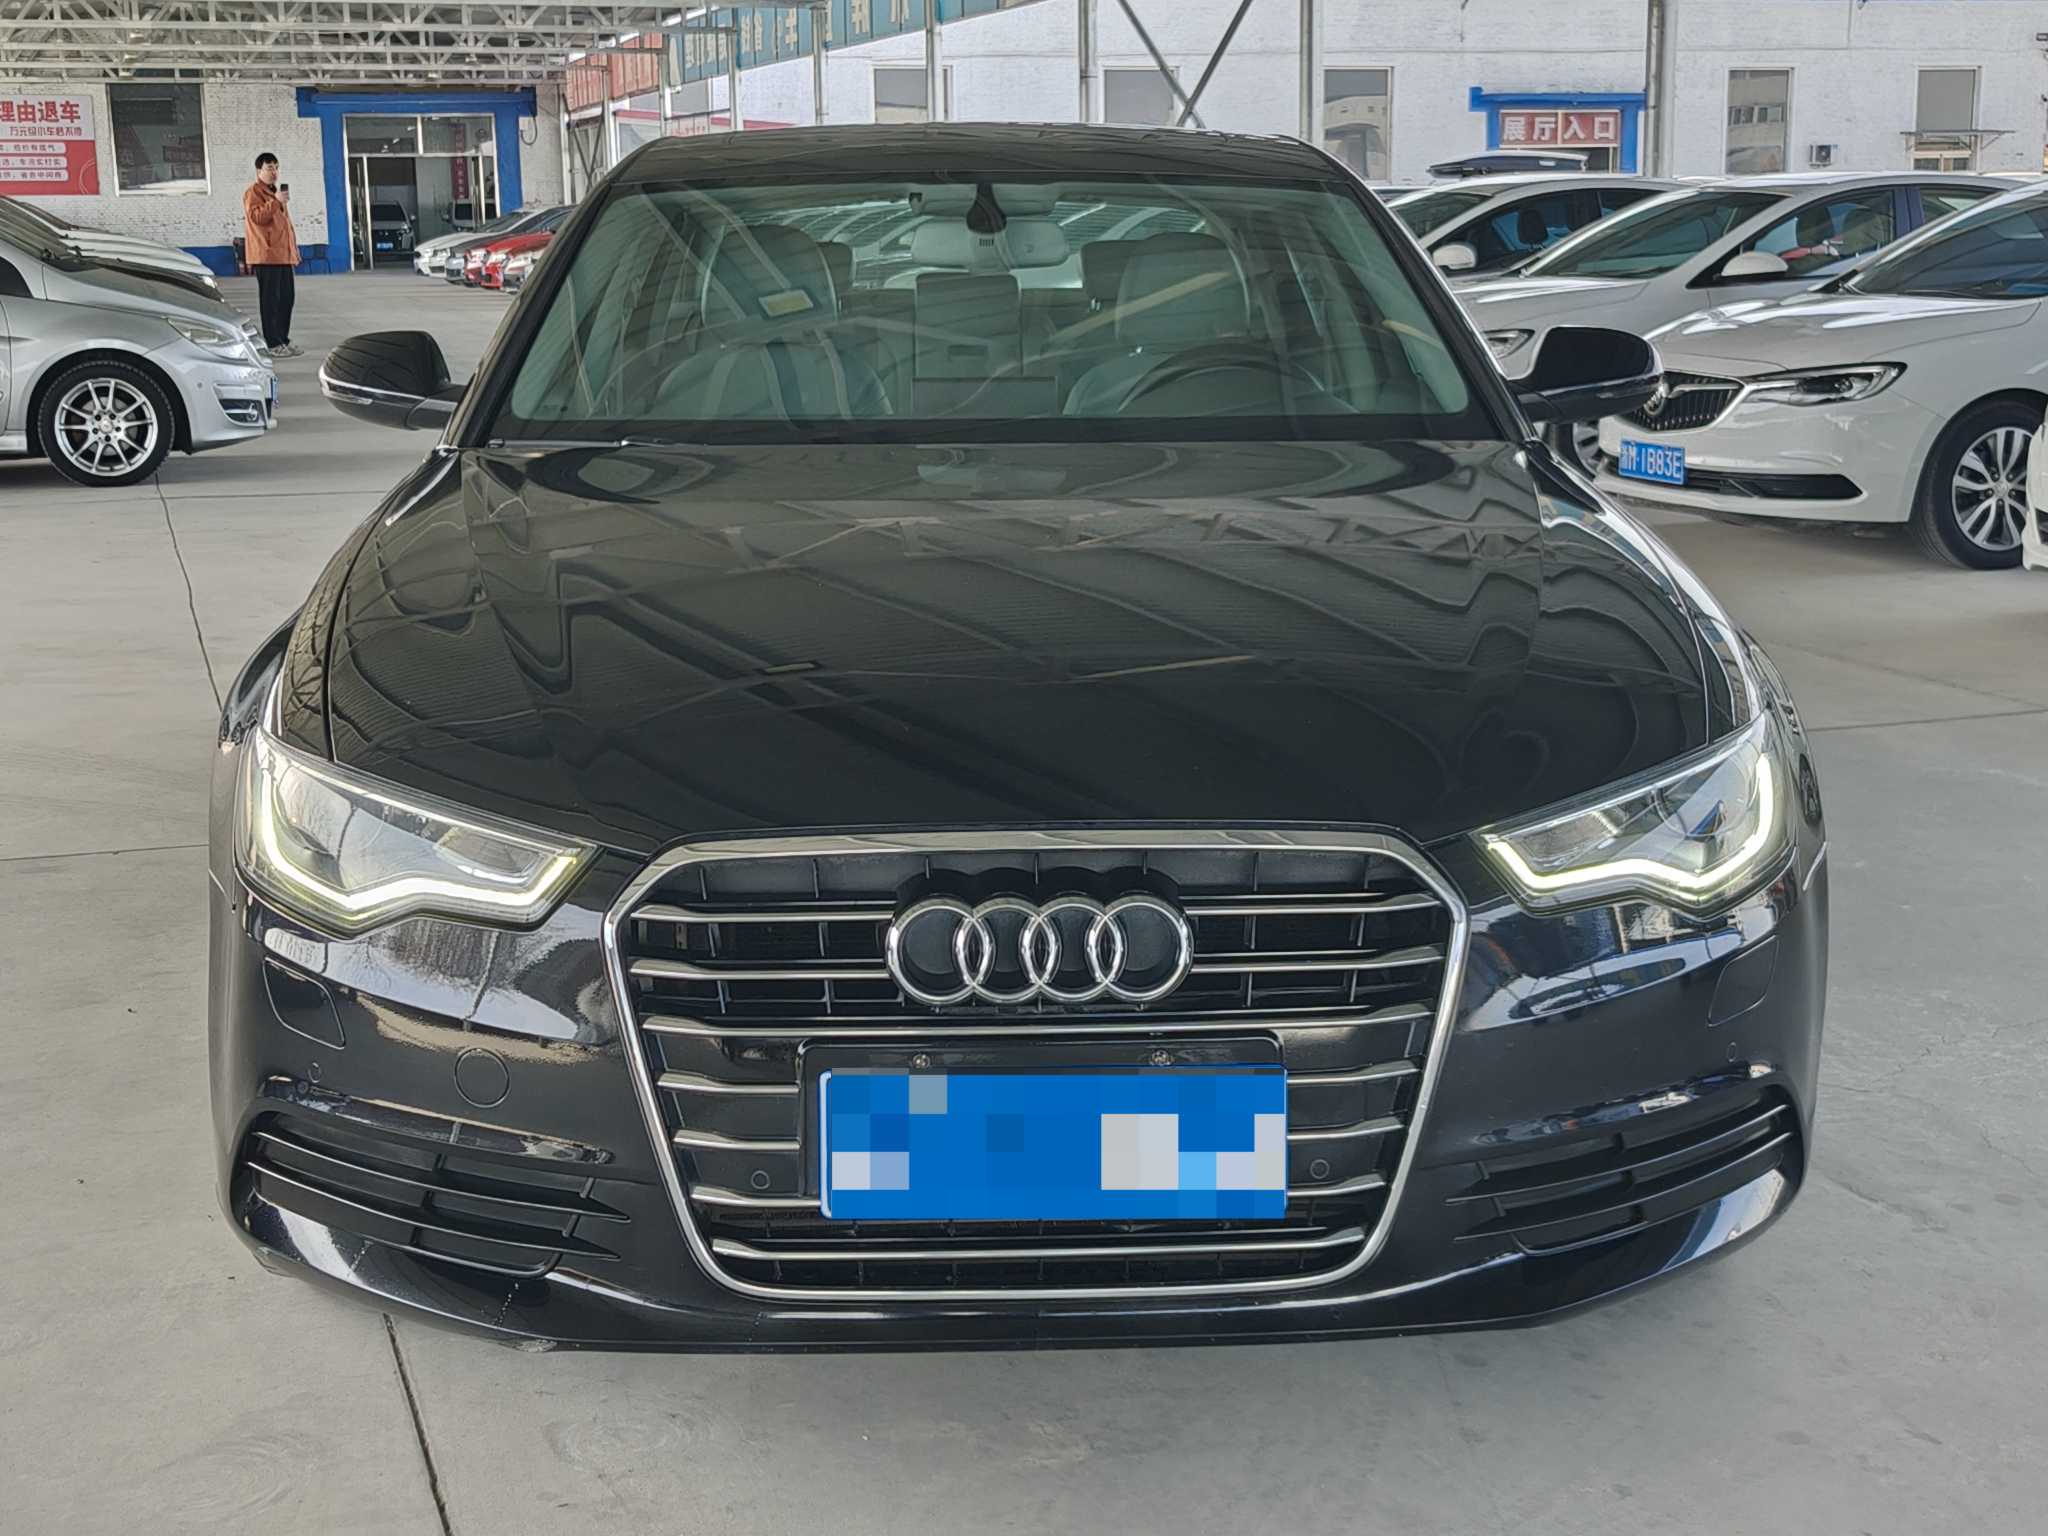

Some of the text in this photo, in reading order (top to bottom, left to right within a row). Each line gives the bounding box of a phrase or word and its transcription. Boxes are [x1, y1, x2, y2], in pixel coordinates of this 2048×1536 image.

[0, 100, 81, 124] 理由退车
[1502, 115, 1617, 141] 展厅入口
